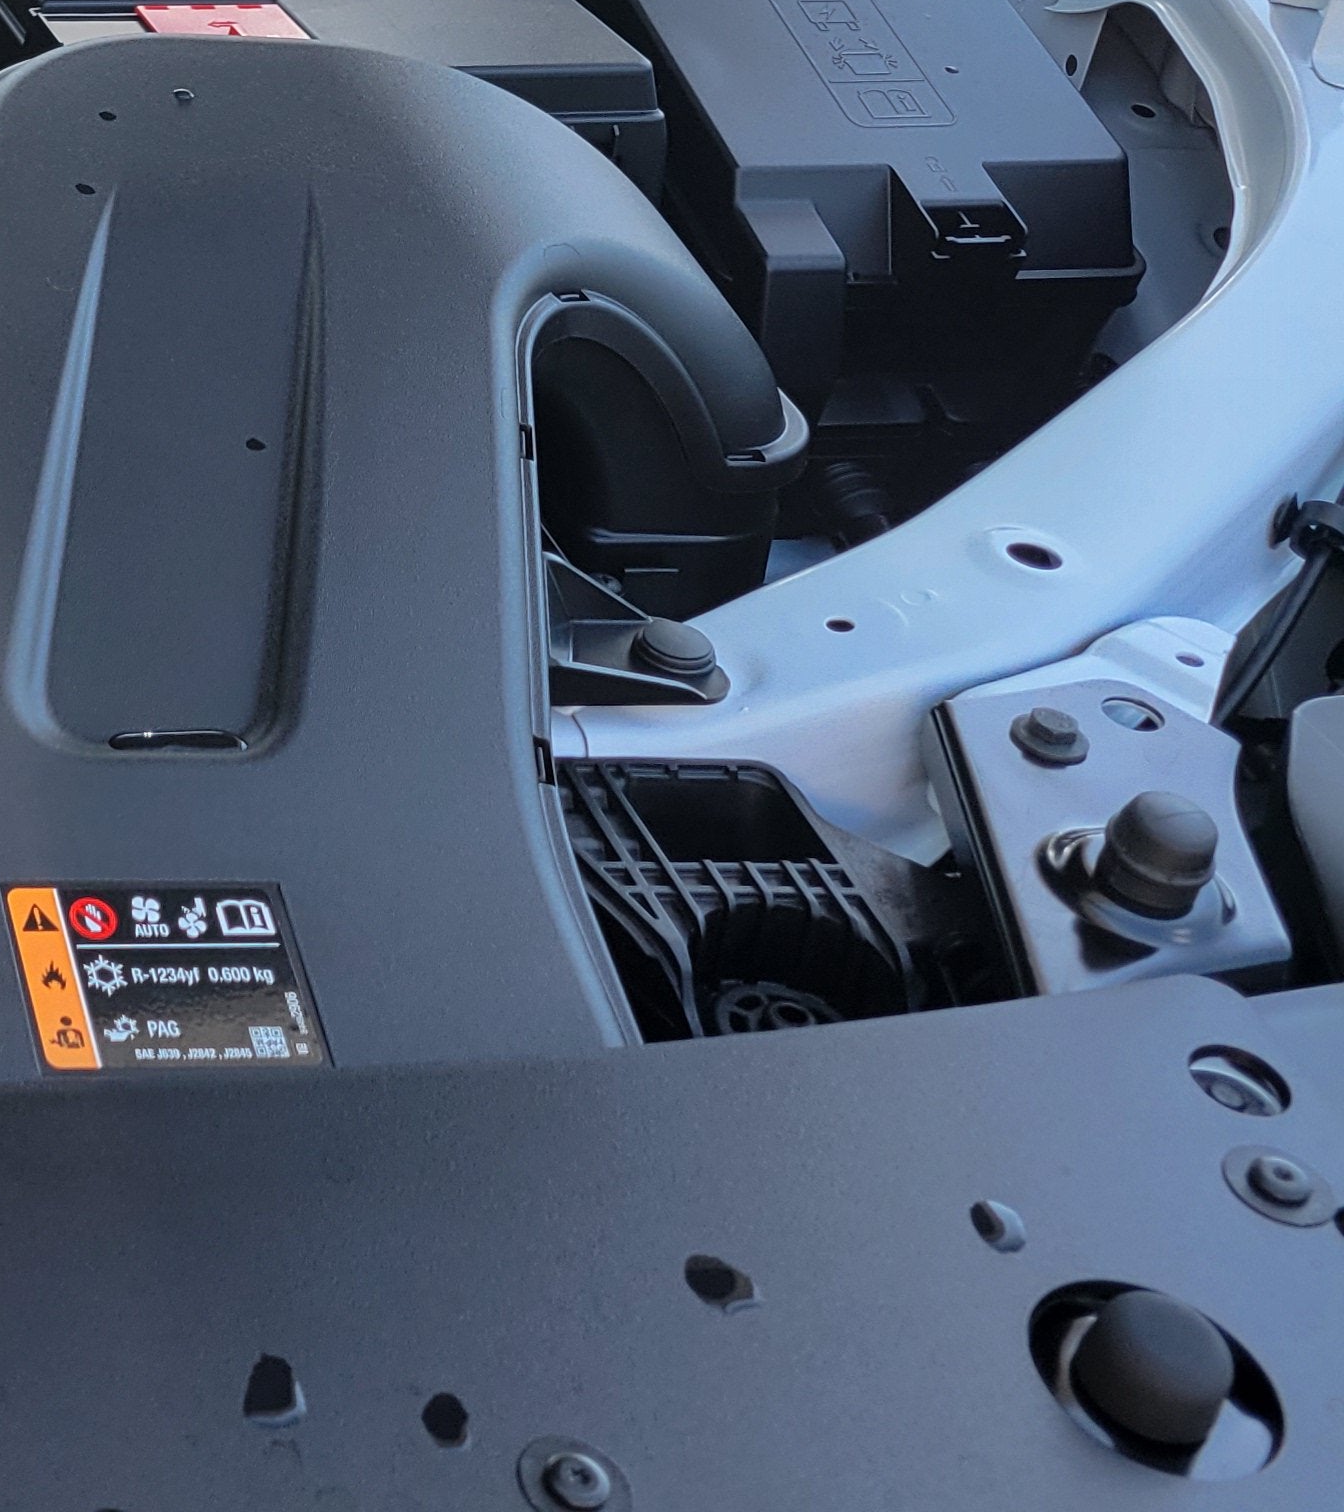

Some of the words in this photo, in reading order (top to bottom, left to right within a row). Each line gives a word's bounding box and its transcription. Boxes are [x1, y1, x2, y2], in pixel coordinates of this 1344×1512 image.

[135, 924, 169, 938] AUTO
[131, 967, 200, 984] R-1234yf
[208, 967, 250, 982] 0.600
[253, 967, 274, 985] kg
[147, 1020, 180, 1039] PAG
